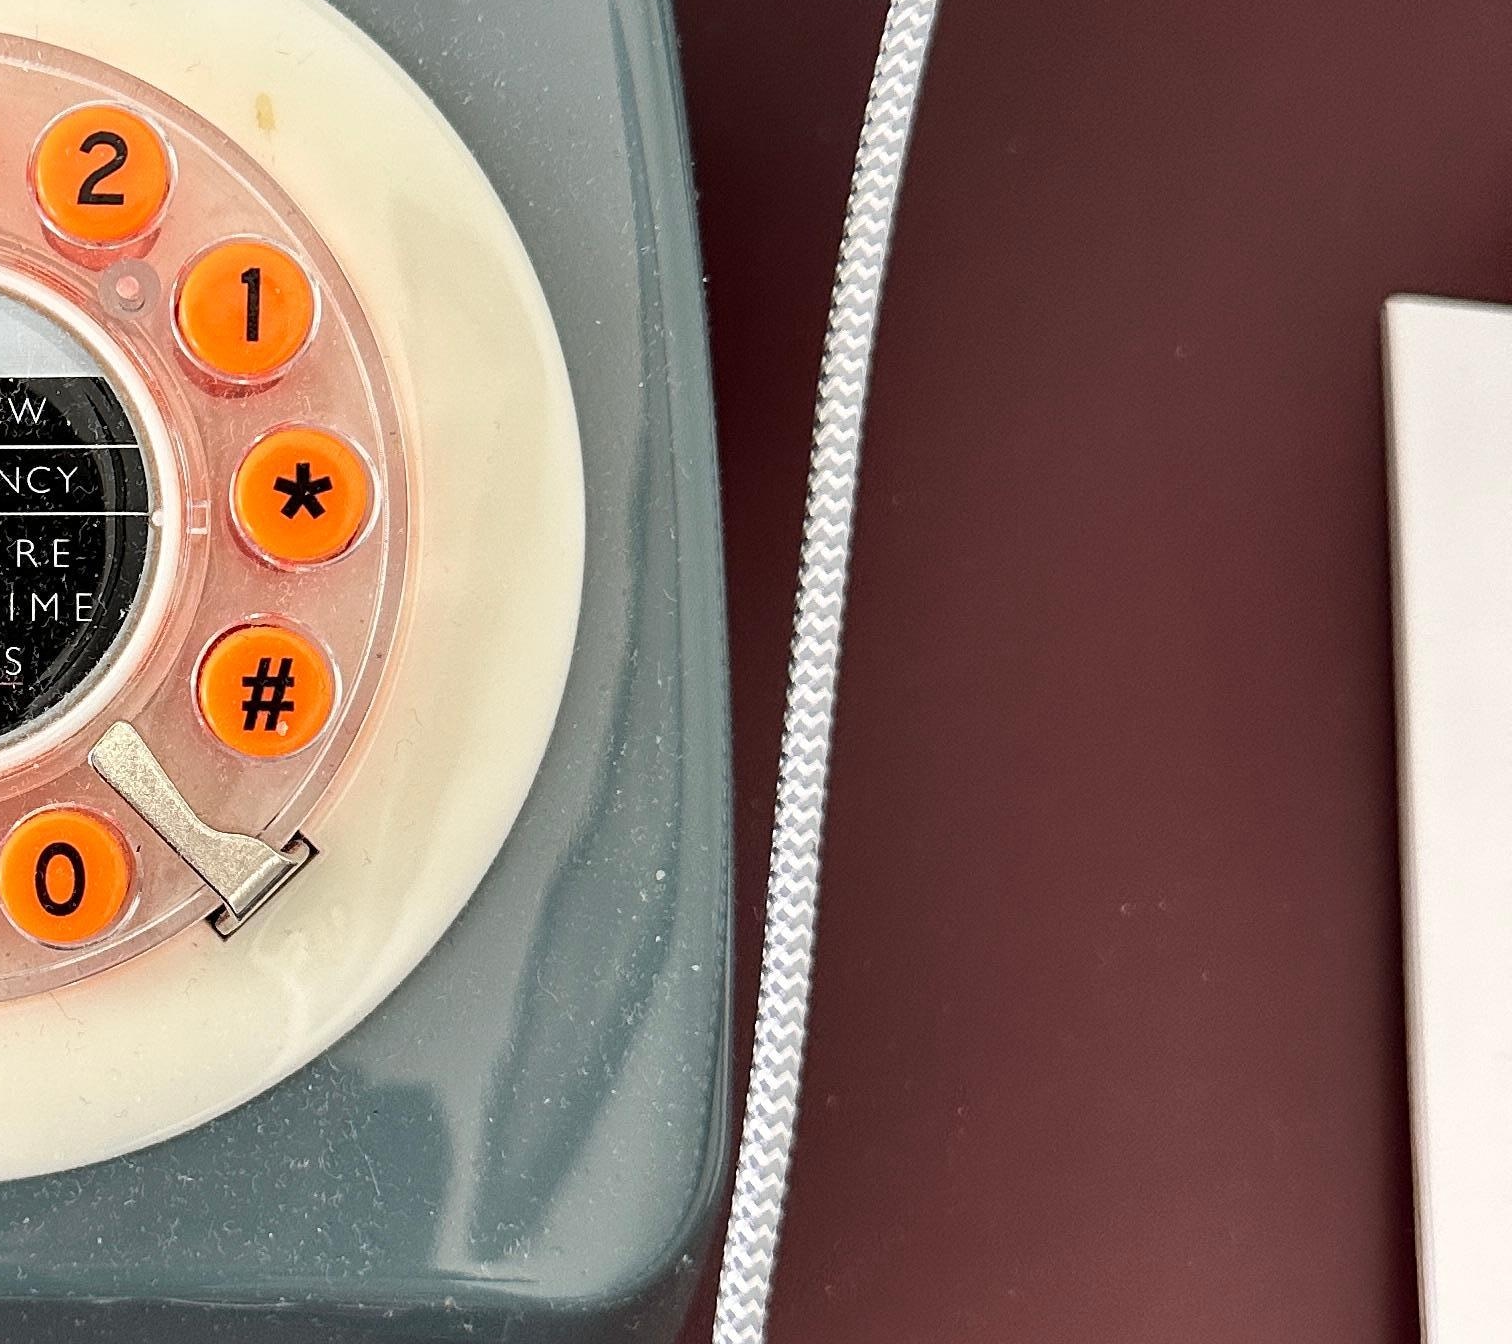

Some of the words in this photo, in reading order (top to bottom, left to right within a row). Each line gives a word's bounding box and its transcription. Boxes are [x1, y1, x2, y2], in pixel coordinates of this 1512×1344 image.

[77, 131, 128, 205] 2
[241, 268, 260, 341] 1
[35, 843, 85, 916] 0
